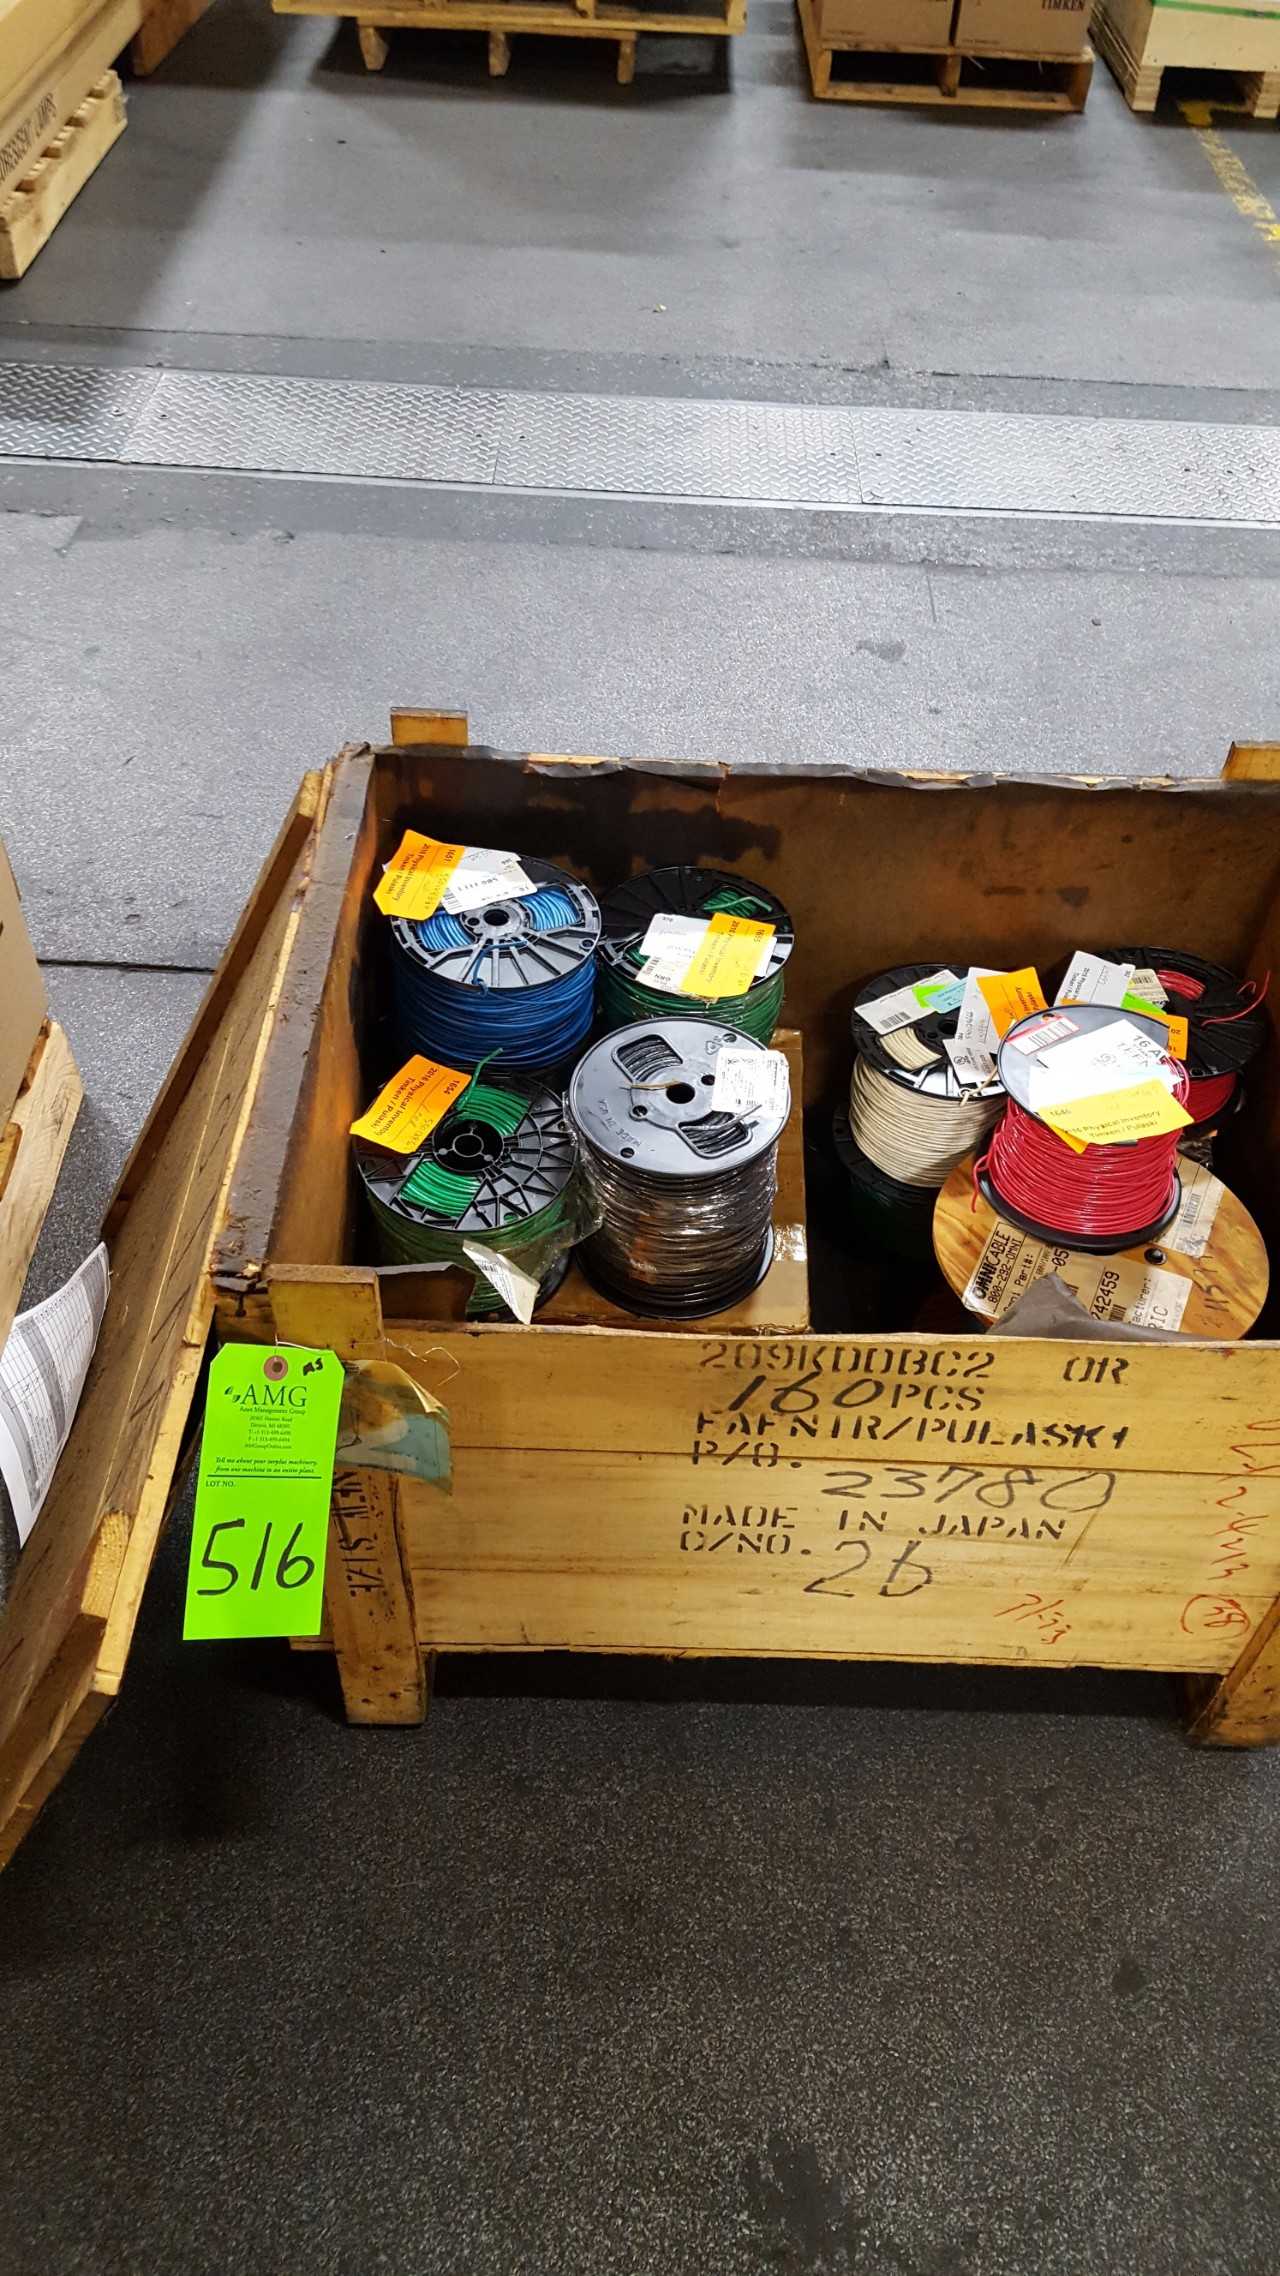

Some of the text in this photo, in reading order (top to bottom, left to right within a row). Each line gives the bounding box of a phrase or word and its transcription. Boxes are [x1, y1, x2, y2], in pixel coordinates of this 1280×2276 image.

[399, 1079, 424, 1109] Physical
[374, 1109, 401, 1136] Inventory
[970, 1230, 1011, 1299] OMNICABLE
[988, 1237, 1021, 1303] 800-292-OMNI
[1063, 1356, 1129, 1384] OR
[241, 1383, 309, 1408] AMG
[692, 1440, 802, 1468] P/O.
[820, 1464, 1116, 1513] 23780
[682, 1503, 1066, 1540] MADE IN JAPAN
[196, 1518, 315, 1595] 516
